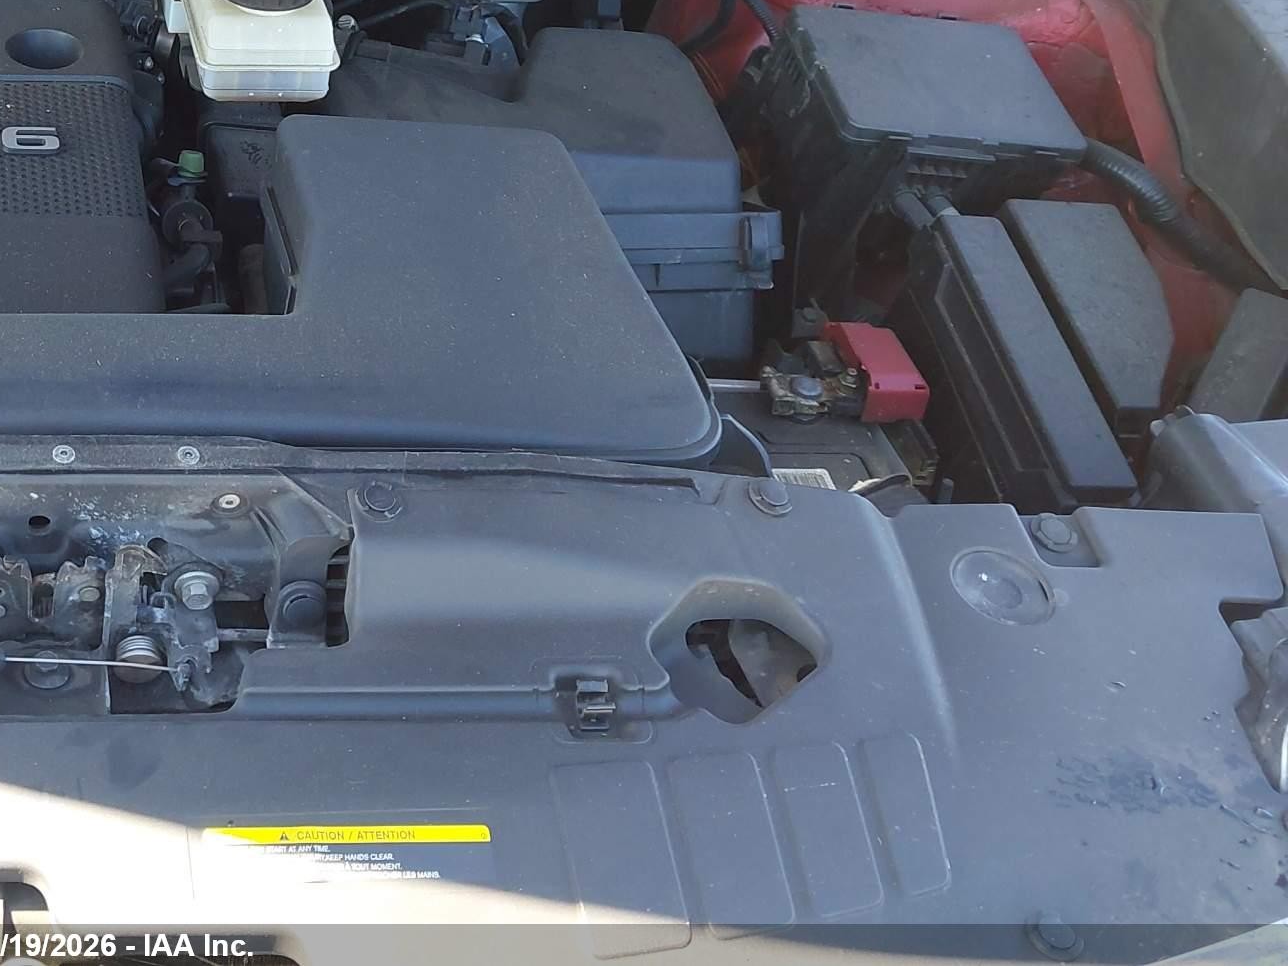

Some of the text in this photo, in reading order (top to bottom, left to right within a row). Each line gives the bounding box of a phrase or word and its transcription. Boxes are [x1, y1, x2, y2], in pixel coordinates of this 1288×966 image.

[297, 831, 344, 841] CAUTION
[357, 830, 416, 840] ATTENTION
[298, 845, 313, 853] ANY
[344, 853, 369, 861] HANDS
